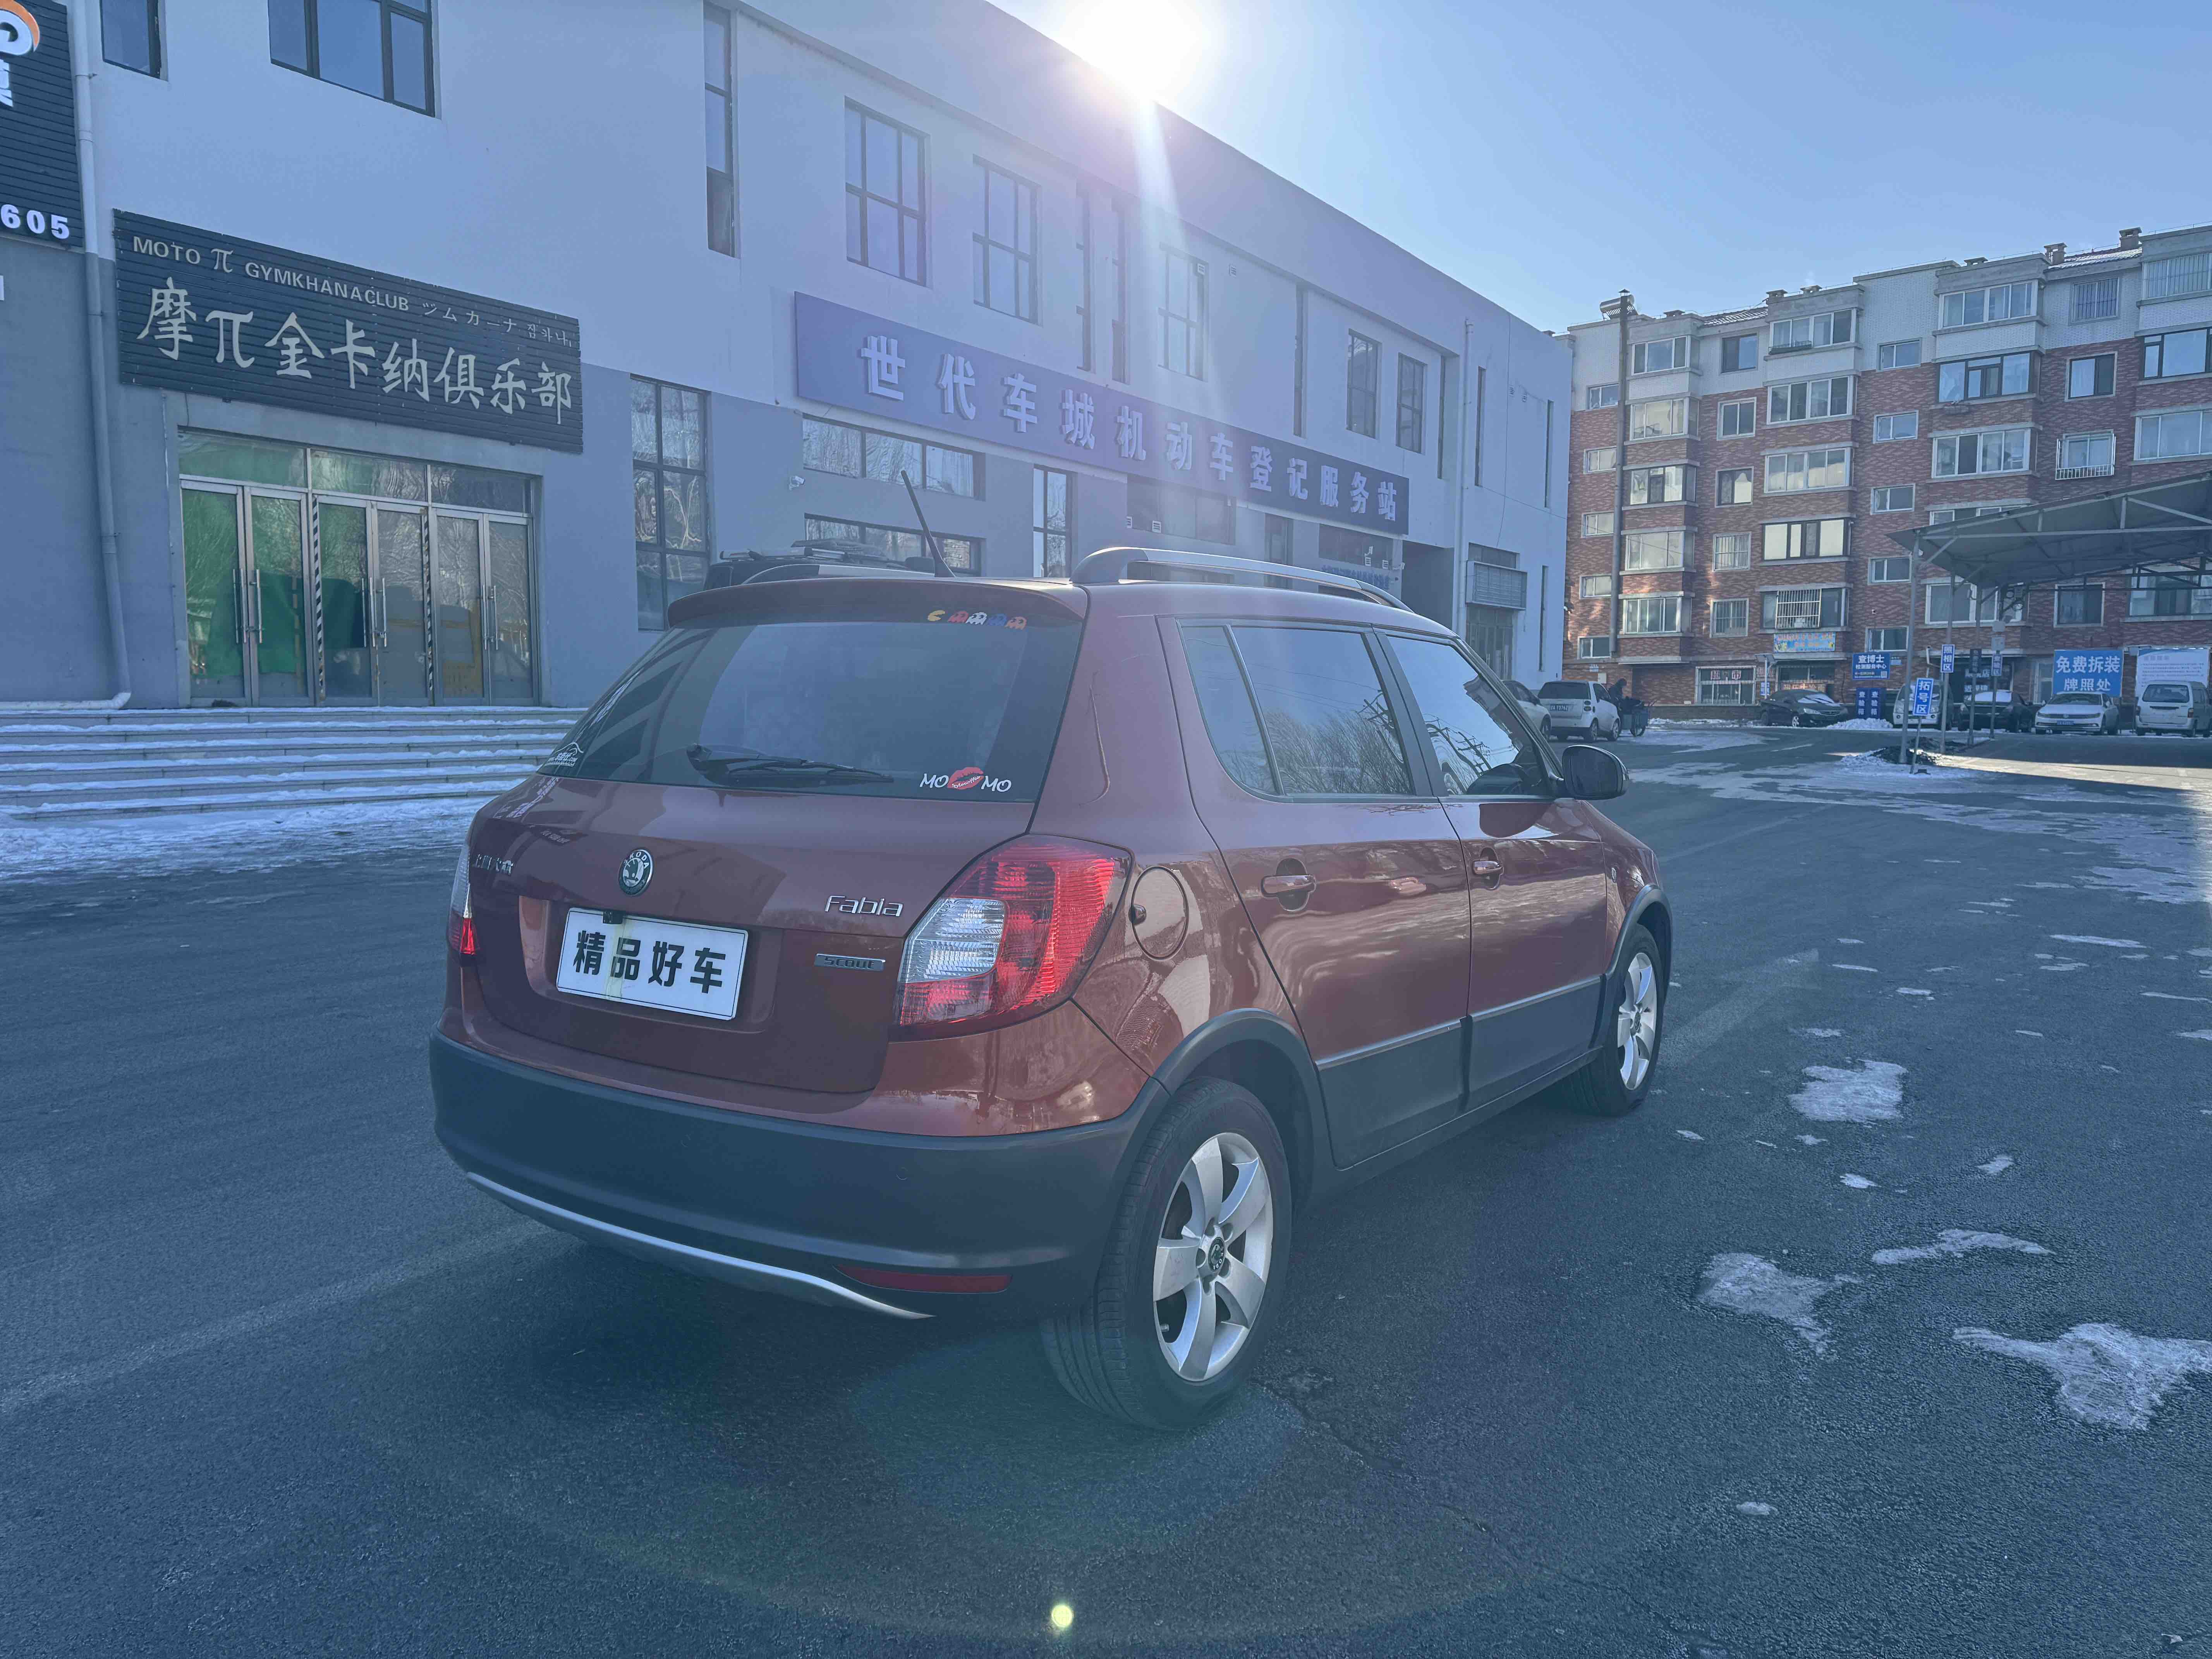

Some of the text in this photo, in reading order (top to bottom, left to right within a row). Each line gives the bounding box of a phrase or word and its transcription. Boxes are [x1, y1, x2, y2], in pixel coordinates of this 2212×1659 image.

[0, 204, 70, 239] 605
[133, 236, 201, 264] MOTO
[245, 262, 409, 311] GYMKHANACLUB
[860, 335, 1396, 522] 世代车城机动车登记服务站
[1943, 646, 1953, 671] 照相区
[2056, 655, 2121, 673] 免费拆装
[1917, 680, 1932, 714] 拓号区
[2063, 678, 2111, 691] 牌照处
[919, 773, 949, 788] MO
[981, 775, 1012, 792] MO
[824, 895, 903, 917] Fabia
[572, 929, 726, 994] 精品好车
